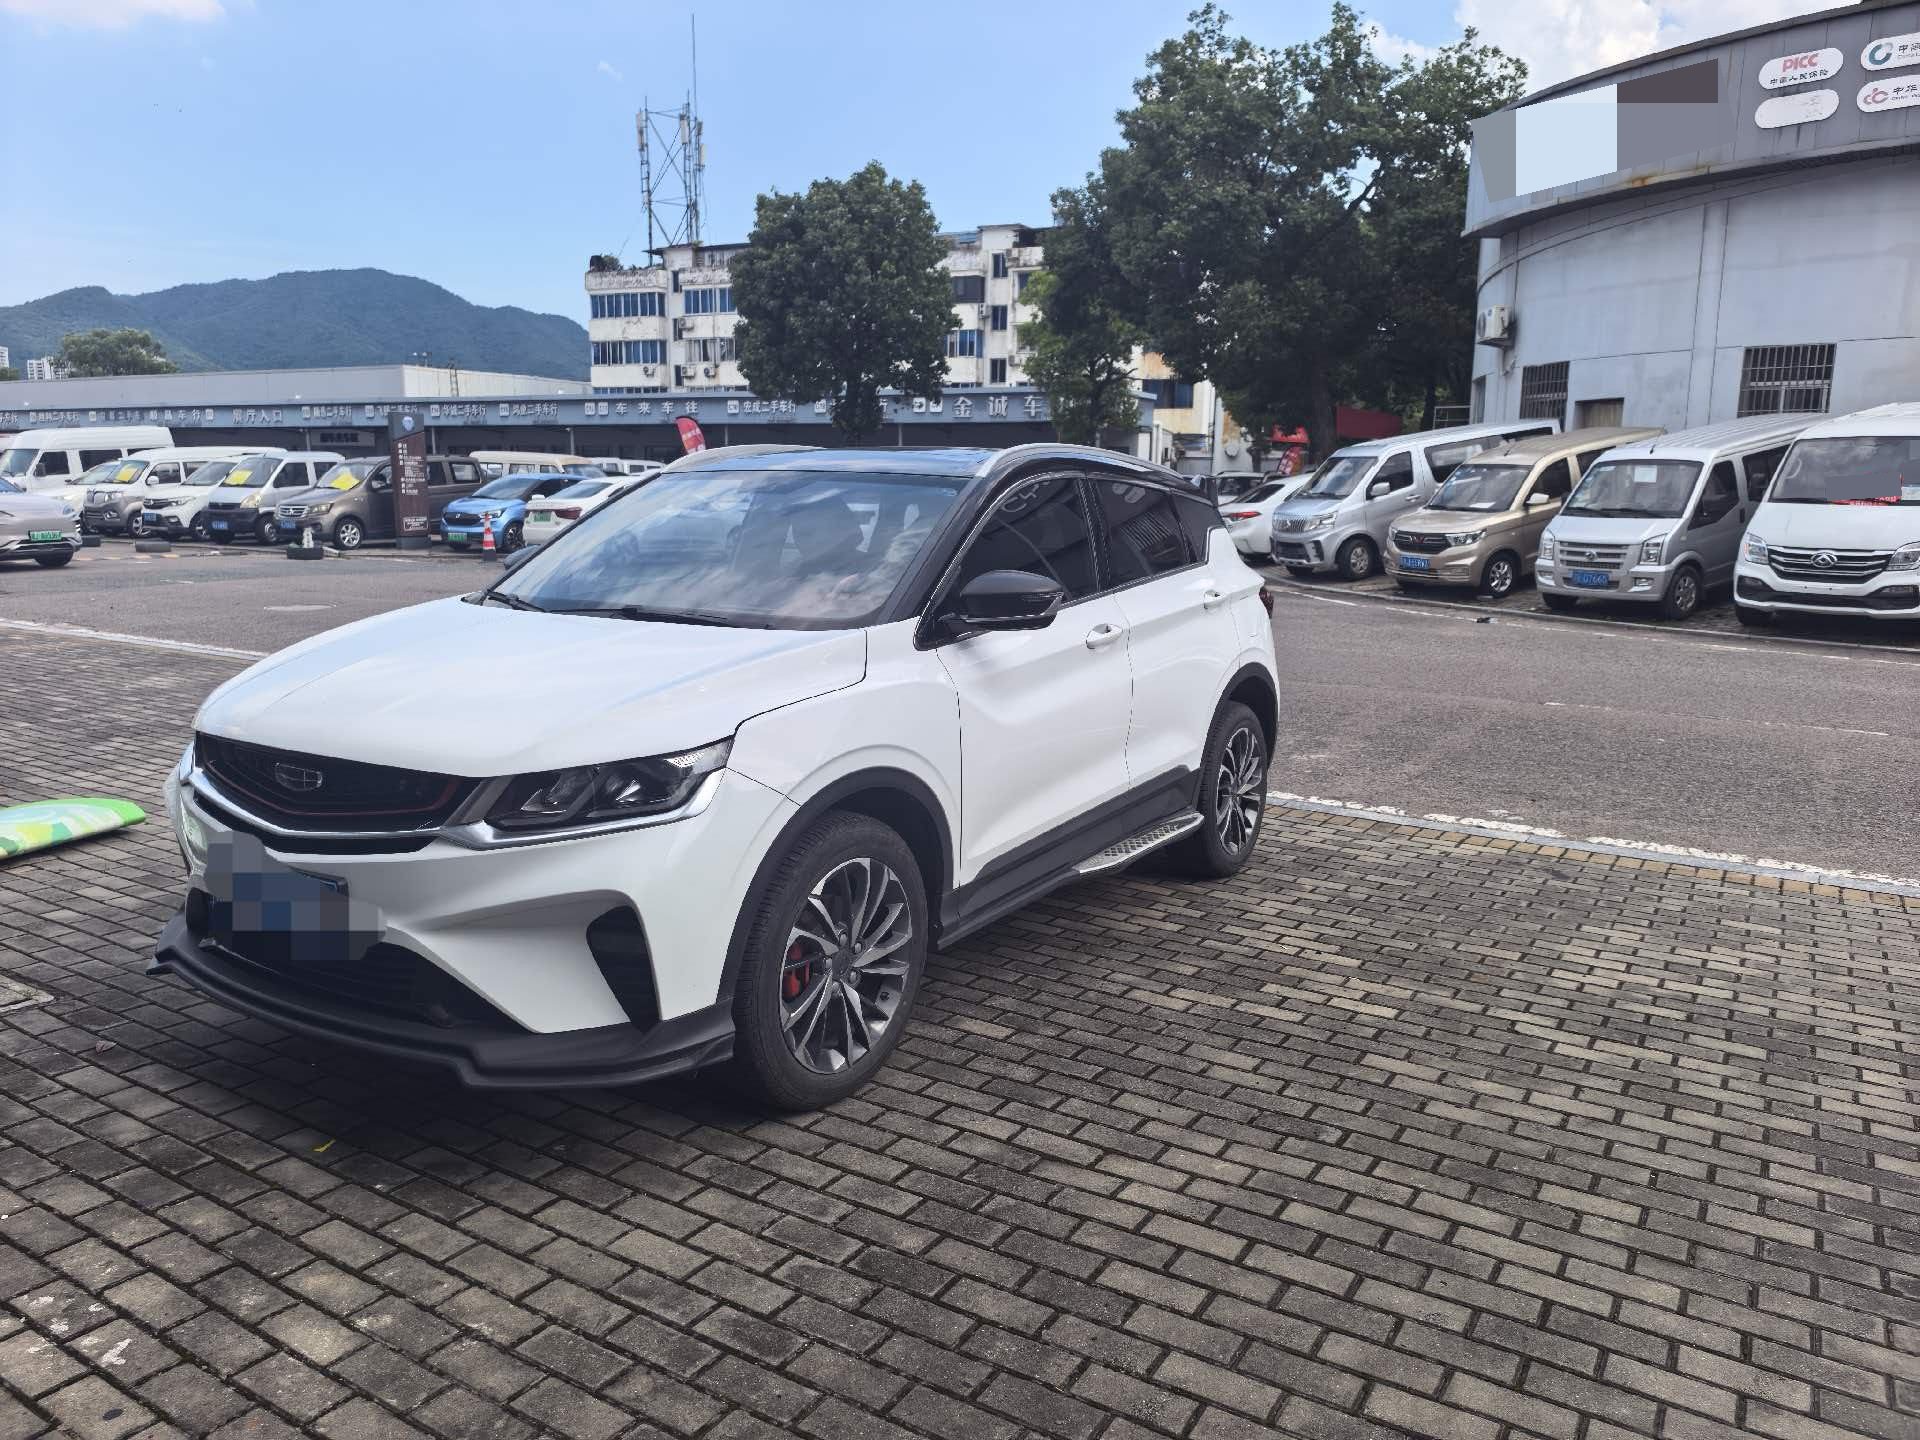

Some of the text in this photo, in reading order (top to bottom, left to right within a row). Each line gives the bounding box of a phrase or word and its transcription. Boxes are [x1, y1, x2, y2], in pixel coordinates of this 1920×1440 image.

[1782, 53, 1819, 73] PICC
[614, 400, 699, 415] 车来车往
[952, 395, 1067, 418] 金诚车
